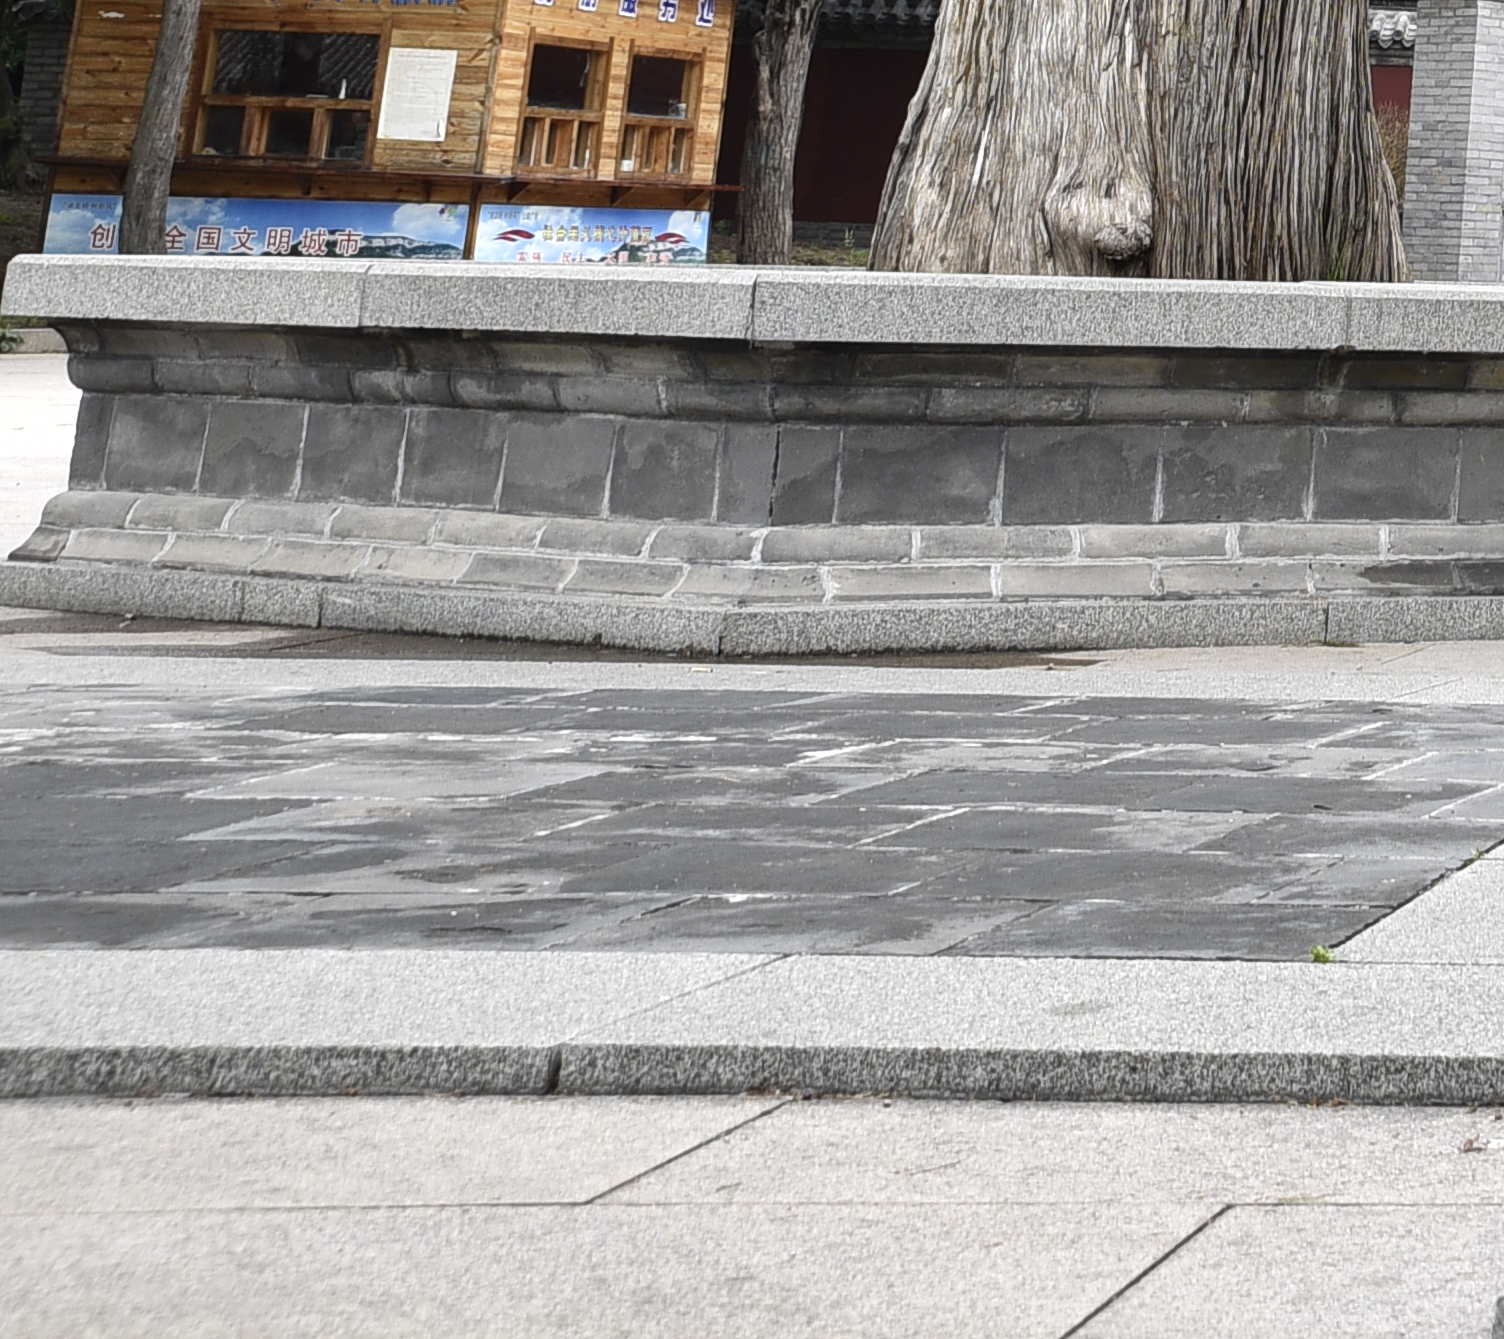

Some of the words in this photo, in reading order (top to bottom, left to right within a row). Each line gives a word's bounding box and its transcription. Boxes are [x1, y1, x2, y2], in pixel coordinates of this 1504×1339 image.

[90, 222, 364, 256] 创全国文明城市
